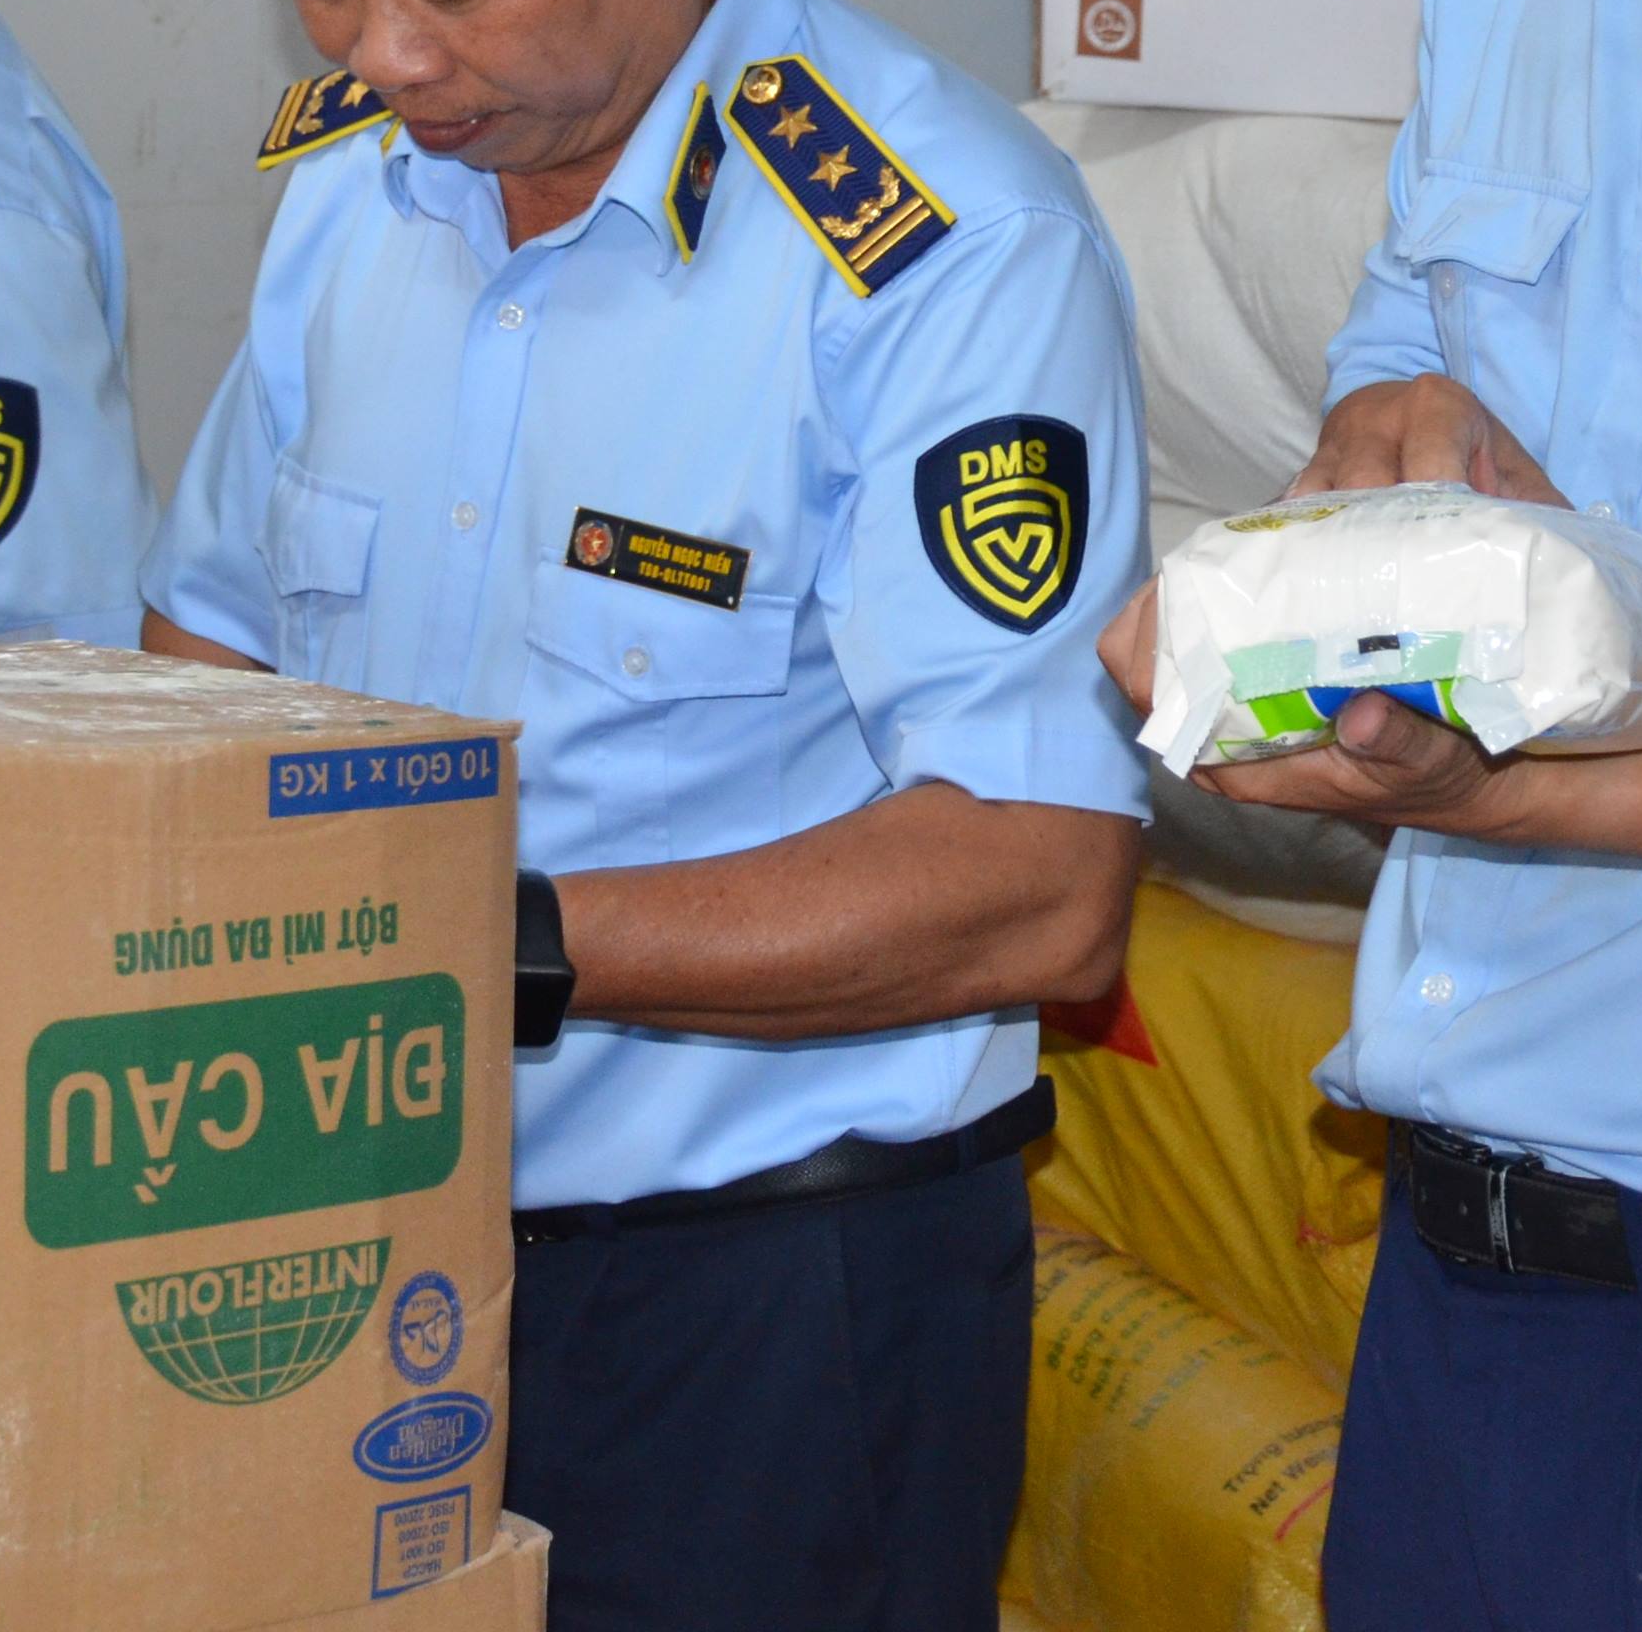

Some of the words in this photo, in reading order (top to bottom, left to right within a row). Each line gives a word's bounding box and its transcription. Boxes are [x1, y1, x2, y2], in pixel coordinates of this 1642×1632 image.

[960, 439, 1047, 486] DMS
[275, 759, 329, 799] KG
[343, 758, 356, 791] 1
[396, 744, 454, 790] GÓI
[460, 741, 492, 781] 10
[114, 918, 215, 977] DỤNG
[225, 919, 269, 963] ĐA
[282, 913, 327, 958] MÌ
[337, 900, 399, 950] BỘT
[305, 1012, 449, 1135] ĐỊA
[46, 1048, 266, 1206] CẦU
[127, 1242, 383, 1326] INTERFLOUR
